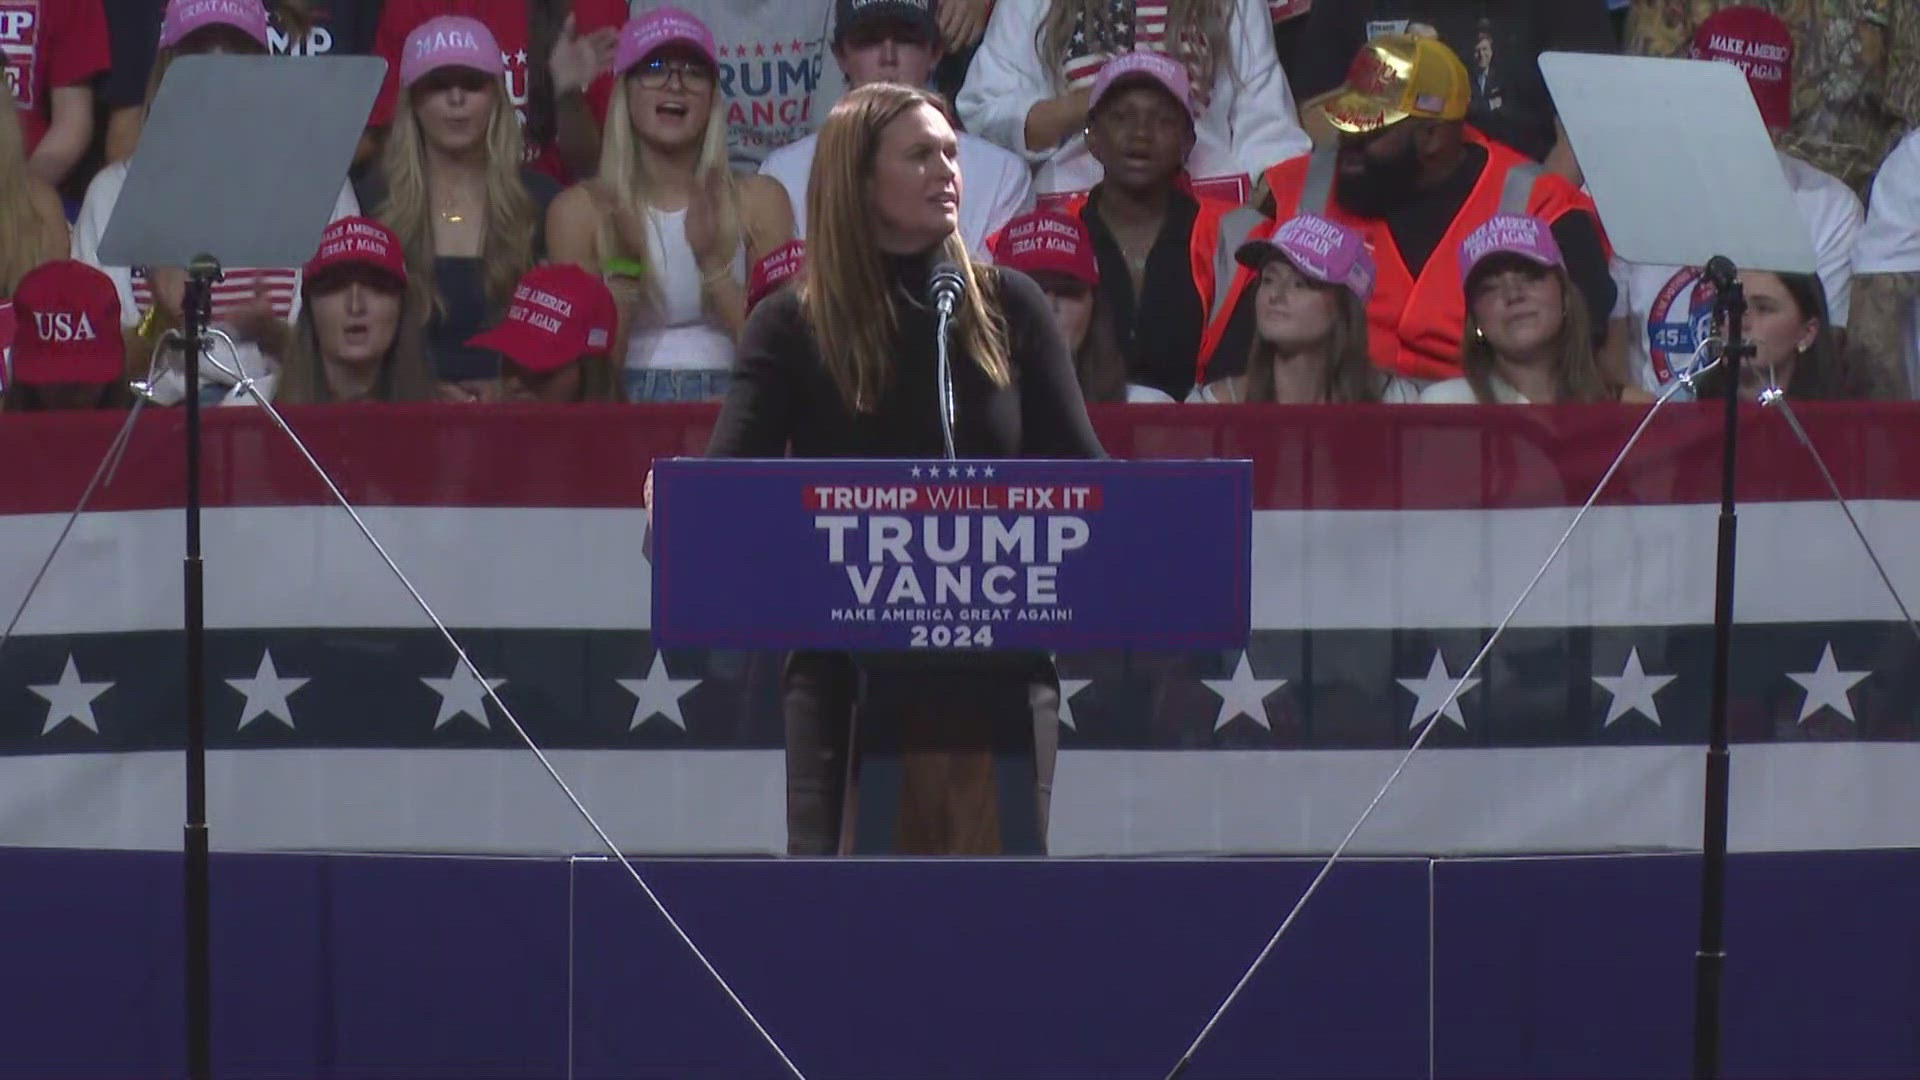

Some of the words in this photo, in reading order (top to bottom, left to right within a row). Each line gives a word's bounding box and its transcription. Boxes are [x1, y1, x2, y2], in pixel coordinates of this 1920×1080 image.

[1708, 34, 1745, 55] MAKE
[346, 223, 389, 244] AMERICA
[1037, 219, 1080, 241] AMERICA
[1488, 216, 1539, 237] AMERICA
[322, 239, 353, 259] GREAT
[356, 239, 386, 257] AGAIN
[1012, 237, 1043, 256] GREAT
[1046, 236, 1077, 255] AGAIN
[1297, 231, 1332, 257] AGAIN
[1501, 231, 1536, 249] AGAIN
[528, 289, 572, 318] AMERICA
[33, 311, 96, 341] USA
[527, 311, 562, 334] AGAIN
[815, 487, 917, 509] TRUMP
[926, 487, 998, 509] WILL
[1008, 487, 1054, 509] FIX
[1063, 487, 1090, 509] IT
[815, 515, 1090, 563] TRUMP
[846, 565, 1057, 604] VANCE
[831, 609, 876, 621] MAKE
[882, 609, 953, 621] AMERICA
[959, 609, 1011, 621] GREAT
[1017, 609, 1073, 621] AGAIN!
[910, 625, 994, 647] 2024
